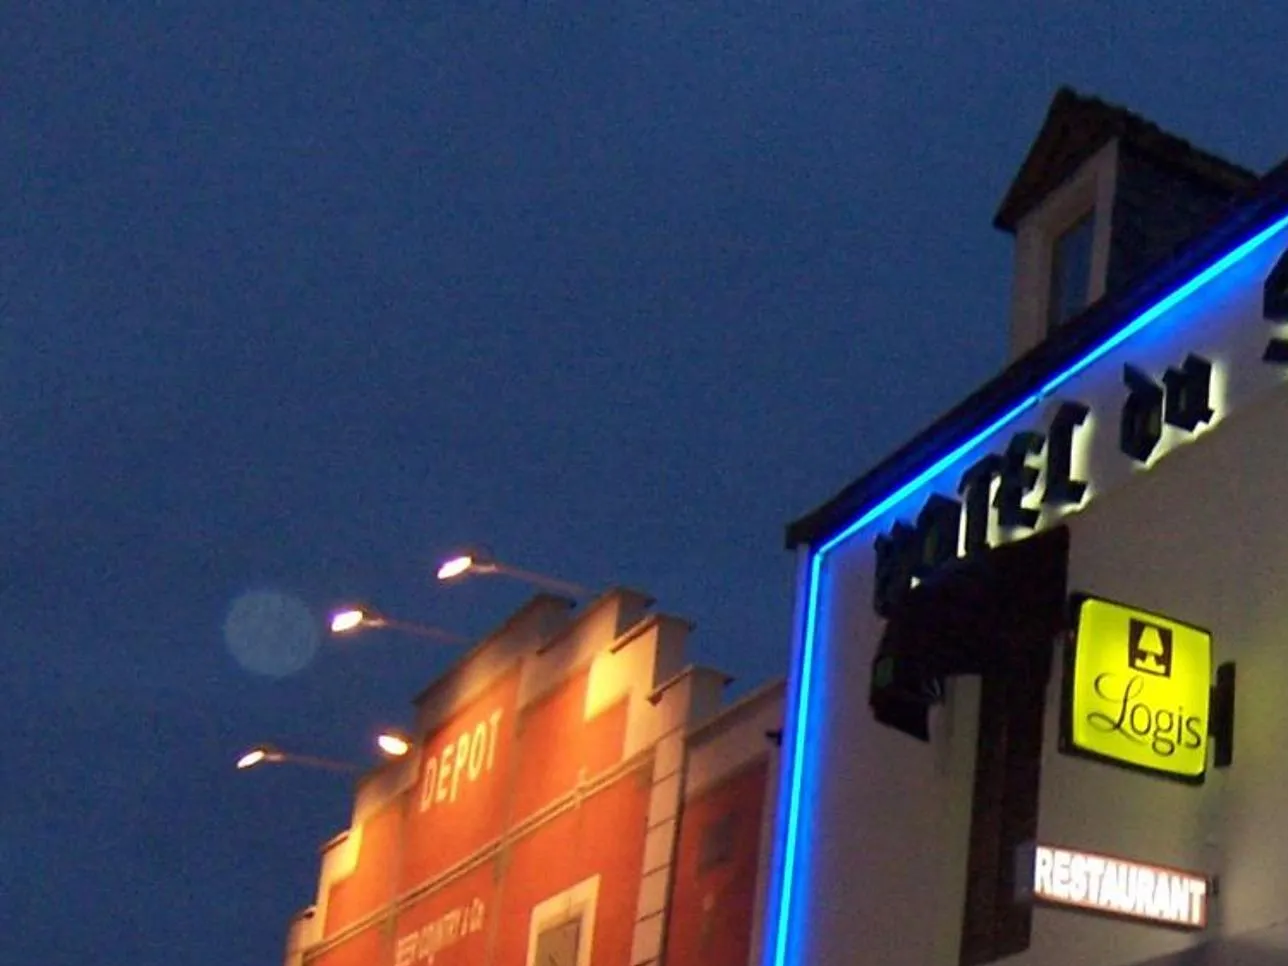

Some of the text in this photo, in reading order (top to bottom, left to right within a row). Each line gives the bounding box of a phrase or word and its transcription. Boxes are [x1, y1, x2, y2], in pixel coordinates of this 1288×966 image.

[1086, 672, 1202, 757] Logis
[420, 707, 502, 812] DEPOT
[1035, 847, 1206, 927] RESTAURANT
